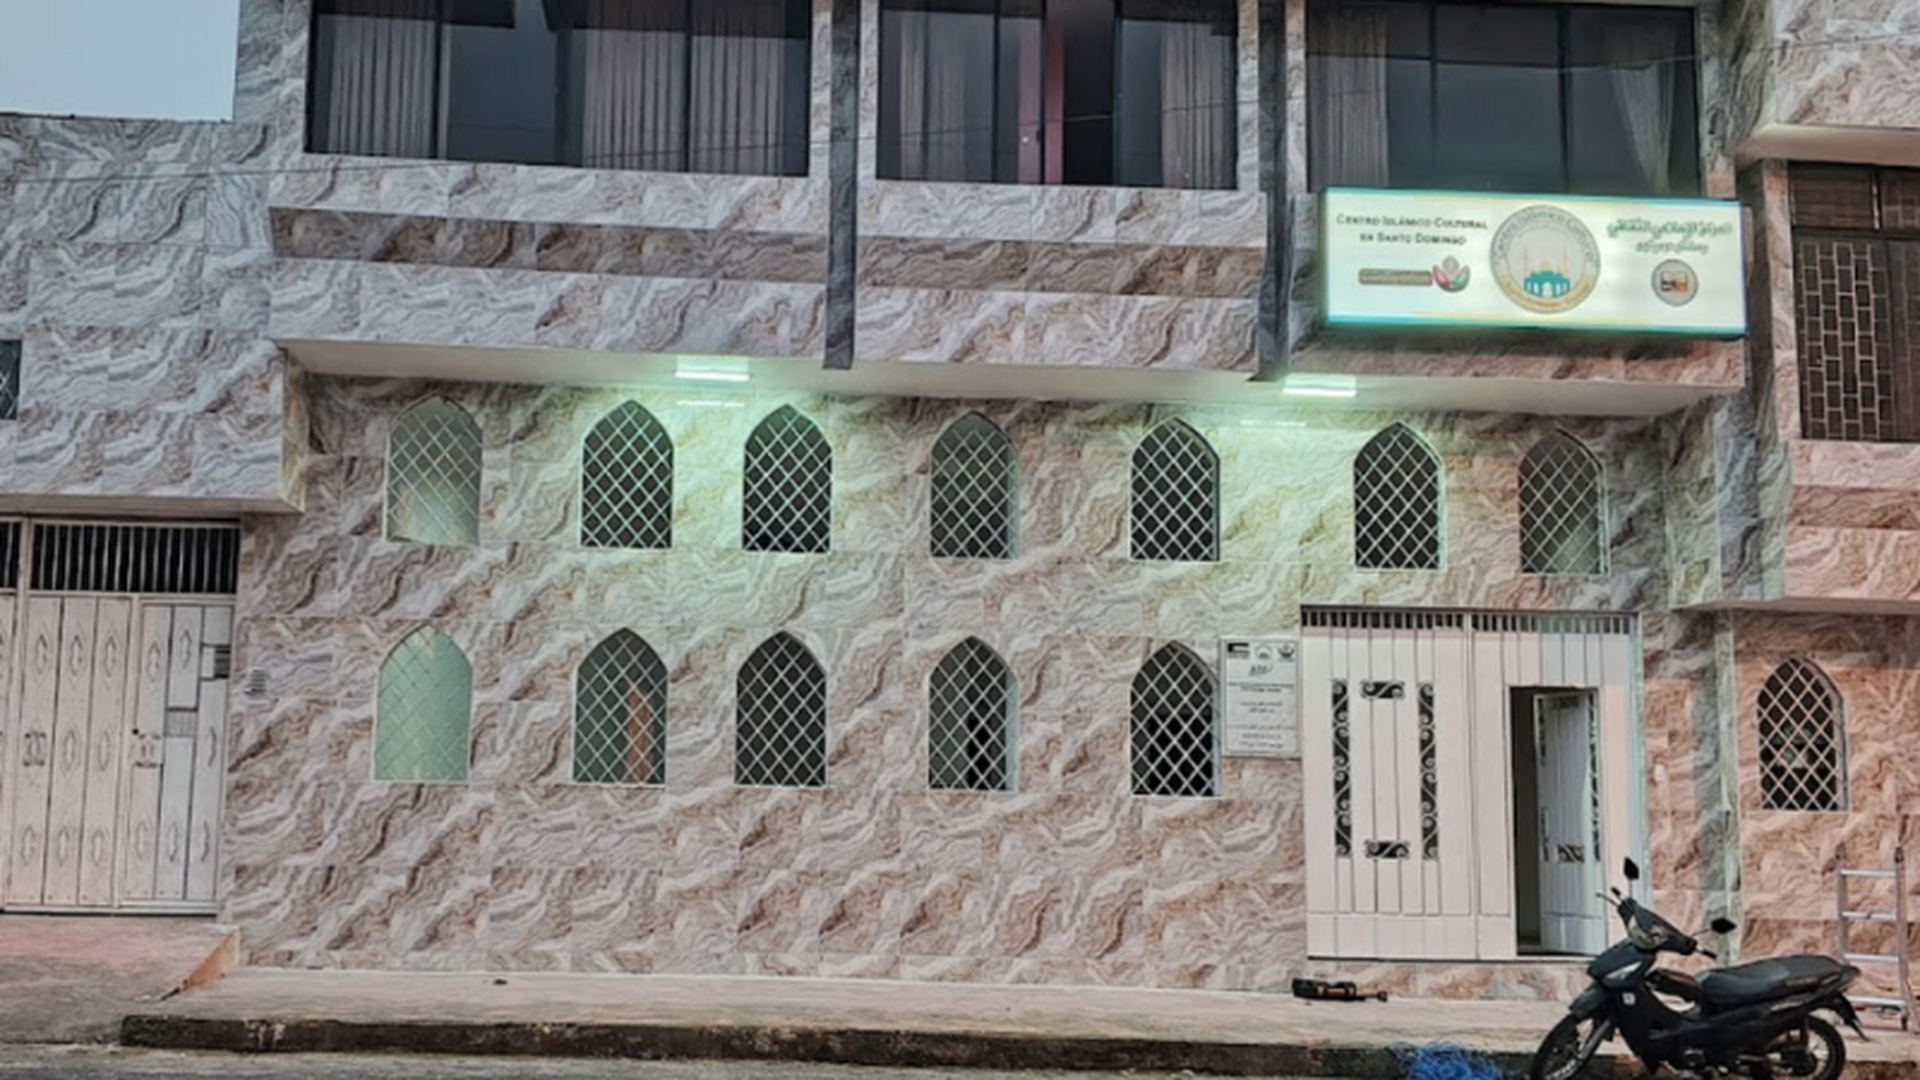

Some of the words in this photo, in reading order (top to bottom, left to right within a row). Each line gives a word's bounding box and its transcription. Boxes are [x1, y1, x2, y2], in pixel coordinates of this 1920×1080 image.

[1336, 213, 1380, 226] CENTRO
[1434, 216, 1488, 230] CULTURAL
[1360, 232, 1374, 242] EN
[1377, 231, 1413, 244] SANTO
[1415, 233, 1467, 246] DOMINGO
